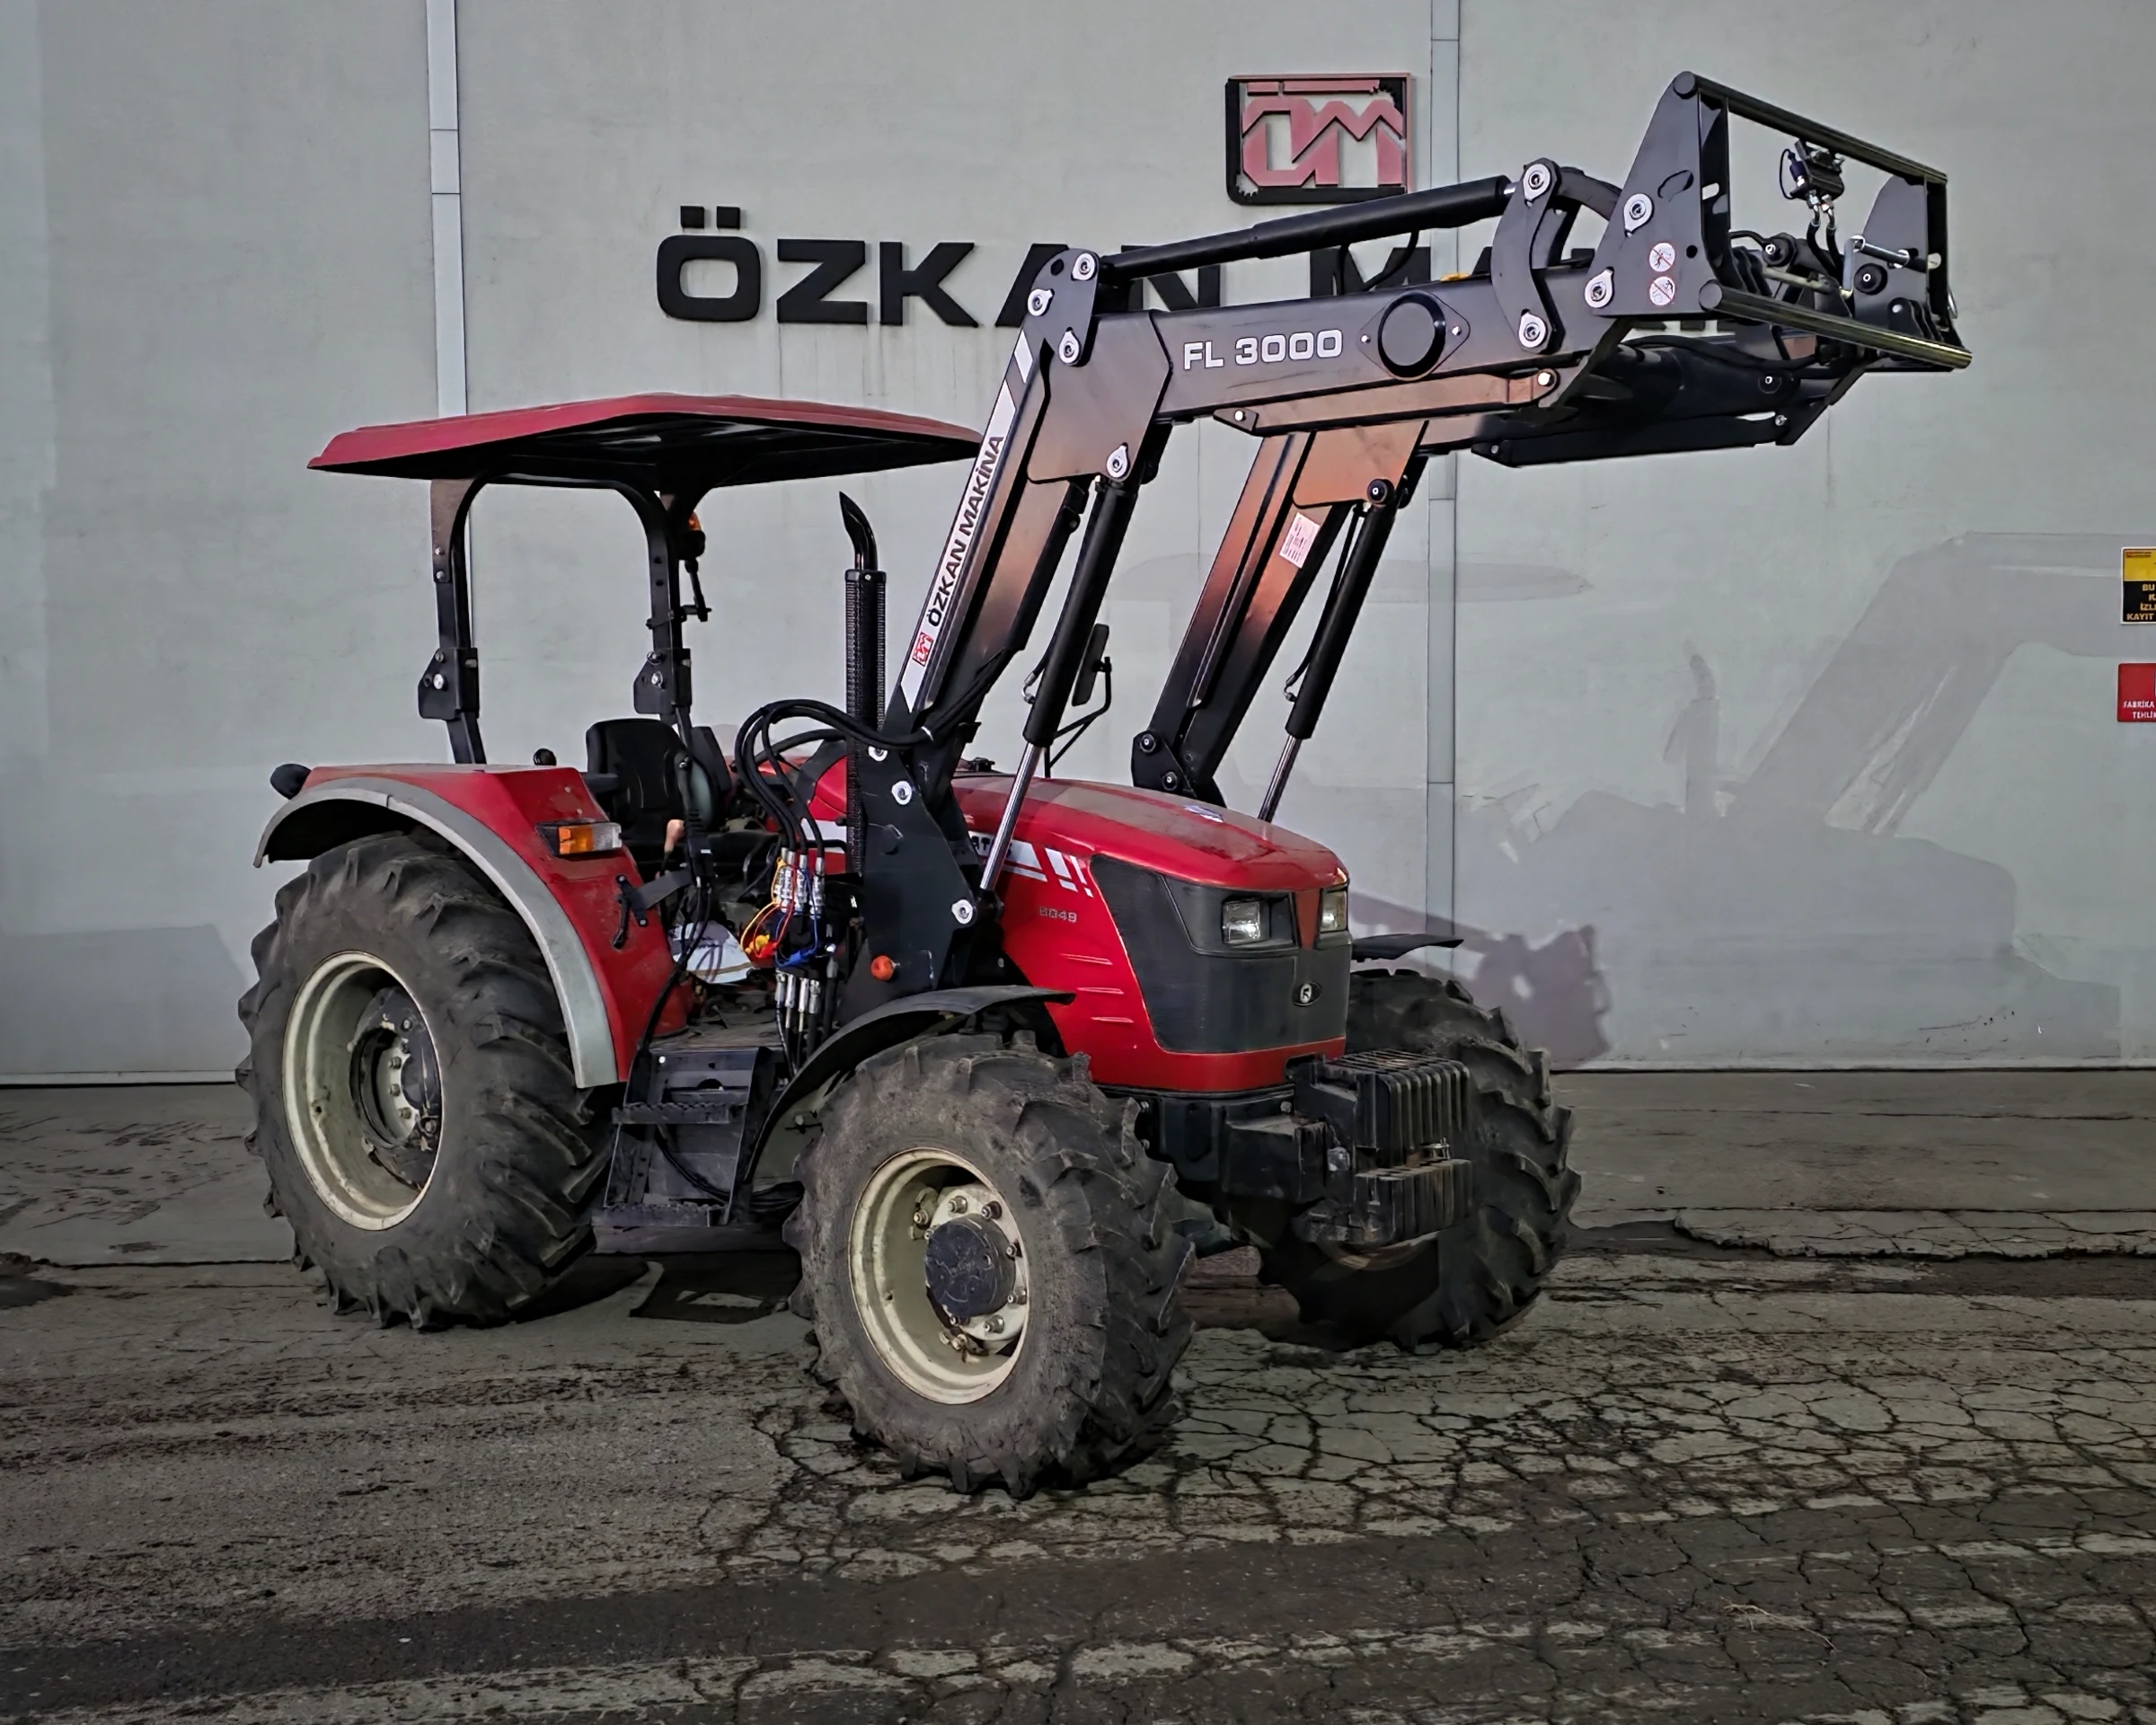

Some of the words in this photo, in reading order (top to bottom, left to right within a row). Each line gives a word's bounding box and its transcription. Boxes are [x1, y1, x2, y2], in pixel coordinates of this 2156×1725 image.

[1183, 341, 1225, 371] FL
[1234, 328, 1344, 366] 3000
[926, 539, 967, 627] ÖZKAN
[959, 436, 1004, 537] MAKİNA
[2148, 593, 2156, 601] K
